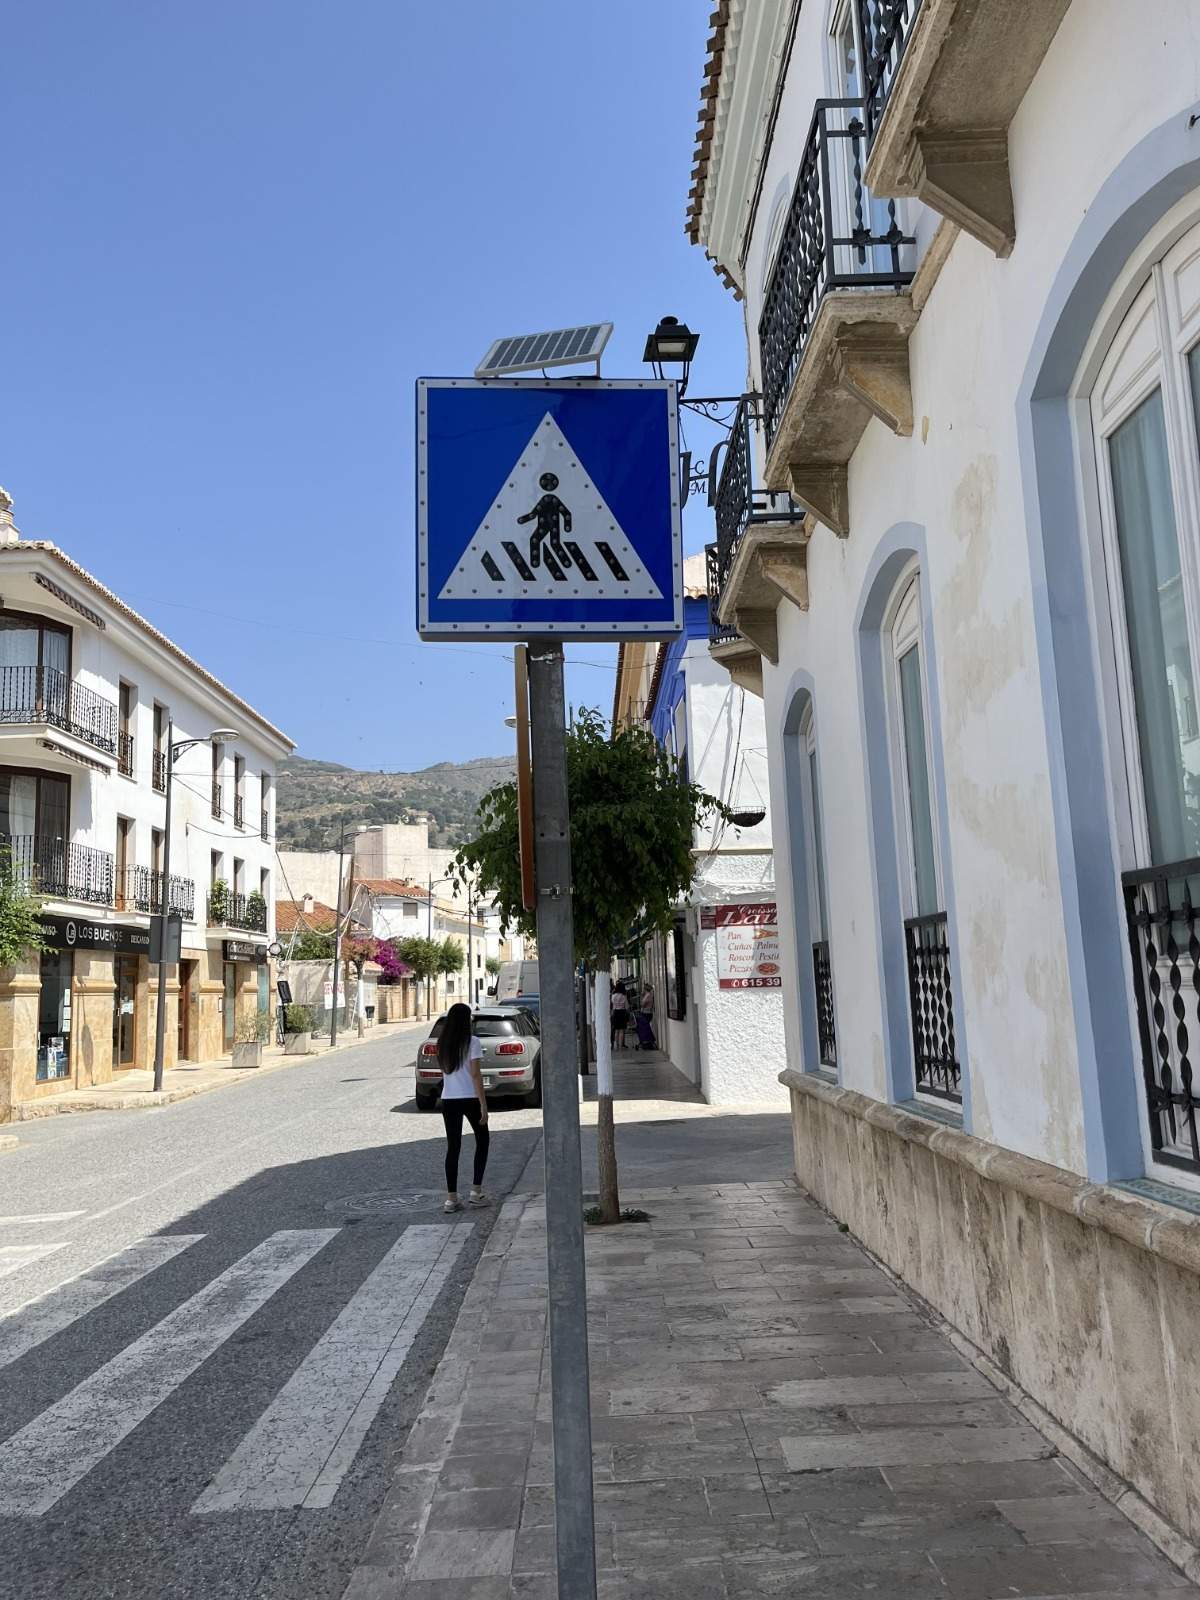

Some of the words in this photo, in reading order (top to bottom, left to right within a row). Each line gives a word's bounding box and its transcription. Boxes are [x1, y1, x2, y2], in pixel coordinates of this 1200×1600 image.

[78, 925, 93, 940] LOS
[94, 927, 123, 943] BUENOS
[741, 978, 763, 987] 615
[766, 977, 780, 986] 39
